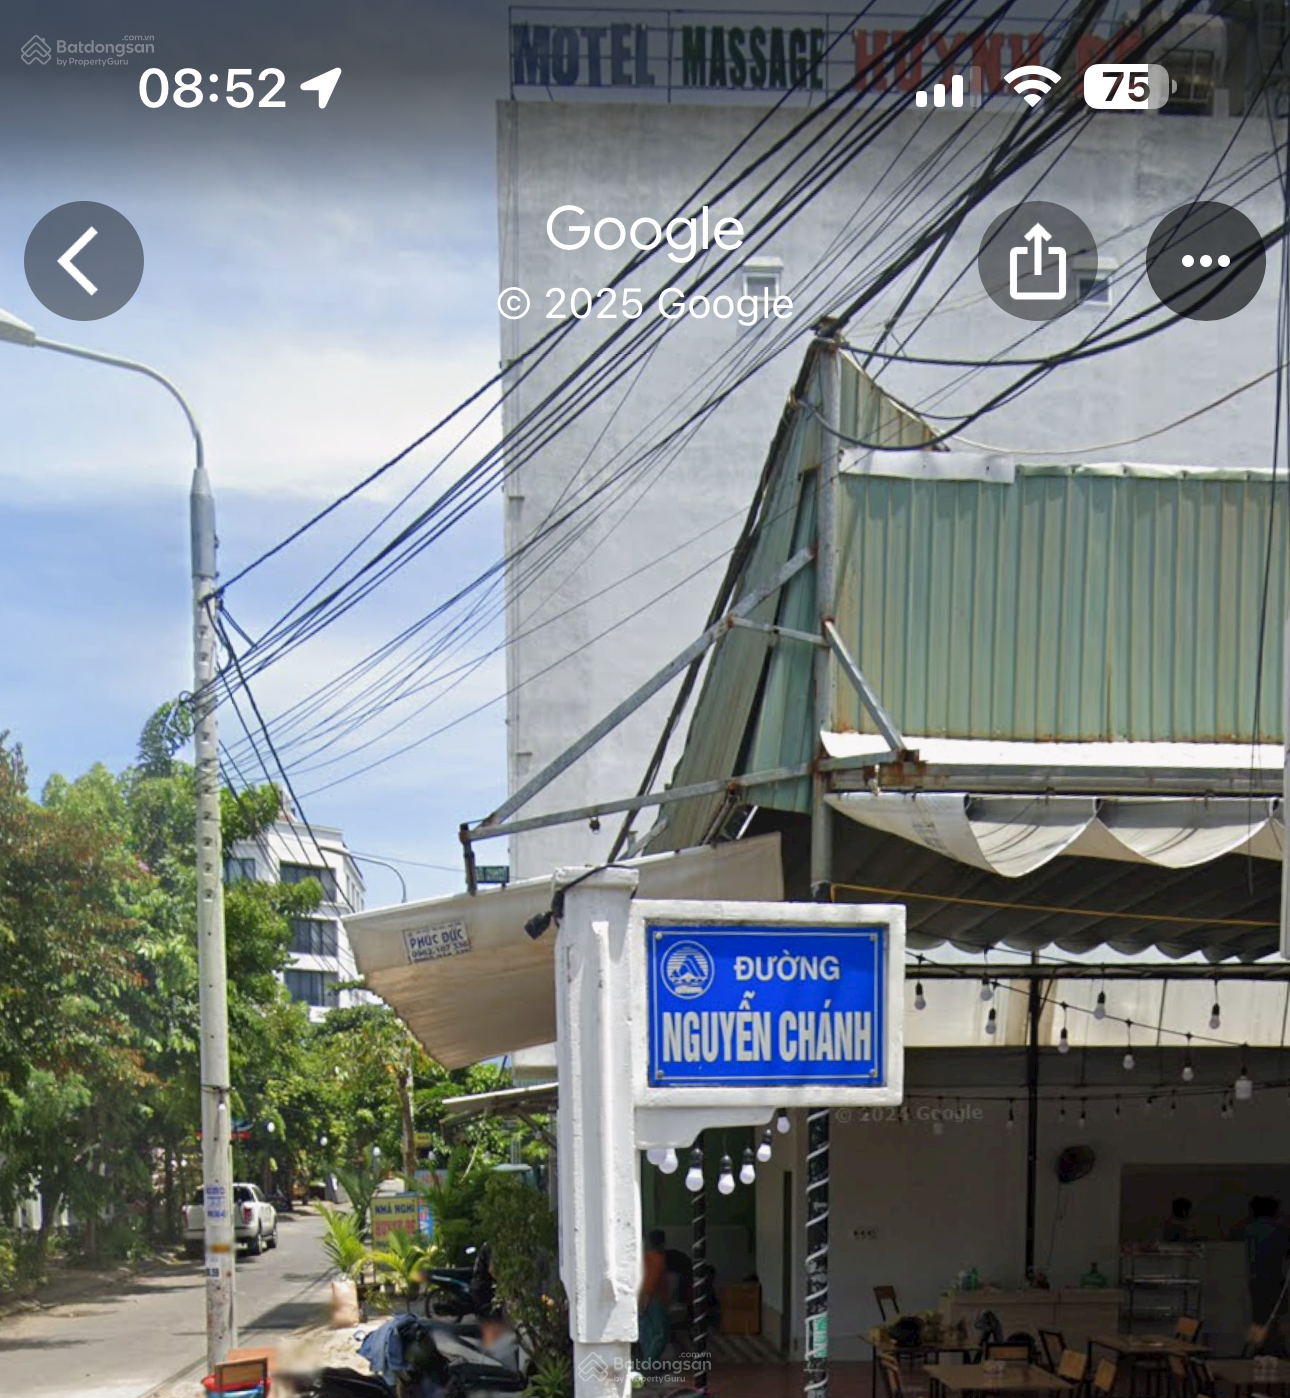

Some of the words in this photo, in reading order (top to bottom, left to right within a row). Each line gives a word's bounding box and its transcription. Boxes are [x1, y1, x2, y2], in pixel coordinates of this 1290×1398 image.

[513, 24, 655, 86] MOTEL
[682, 25, 826, 89] MASSAGE
[733, 949, 841, 982] ĐƯỜNG
[662, 990, 771, 1063] NGUYỄN
[778, 999, 872, 1062] CHÁNH
